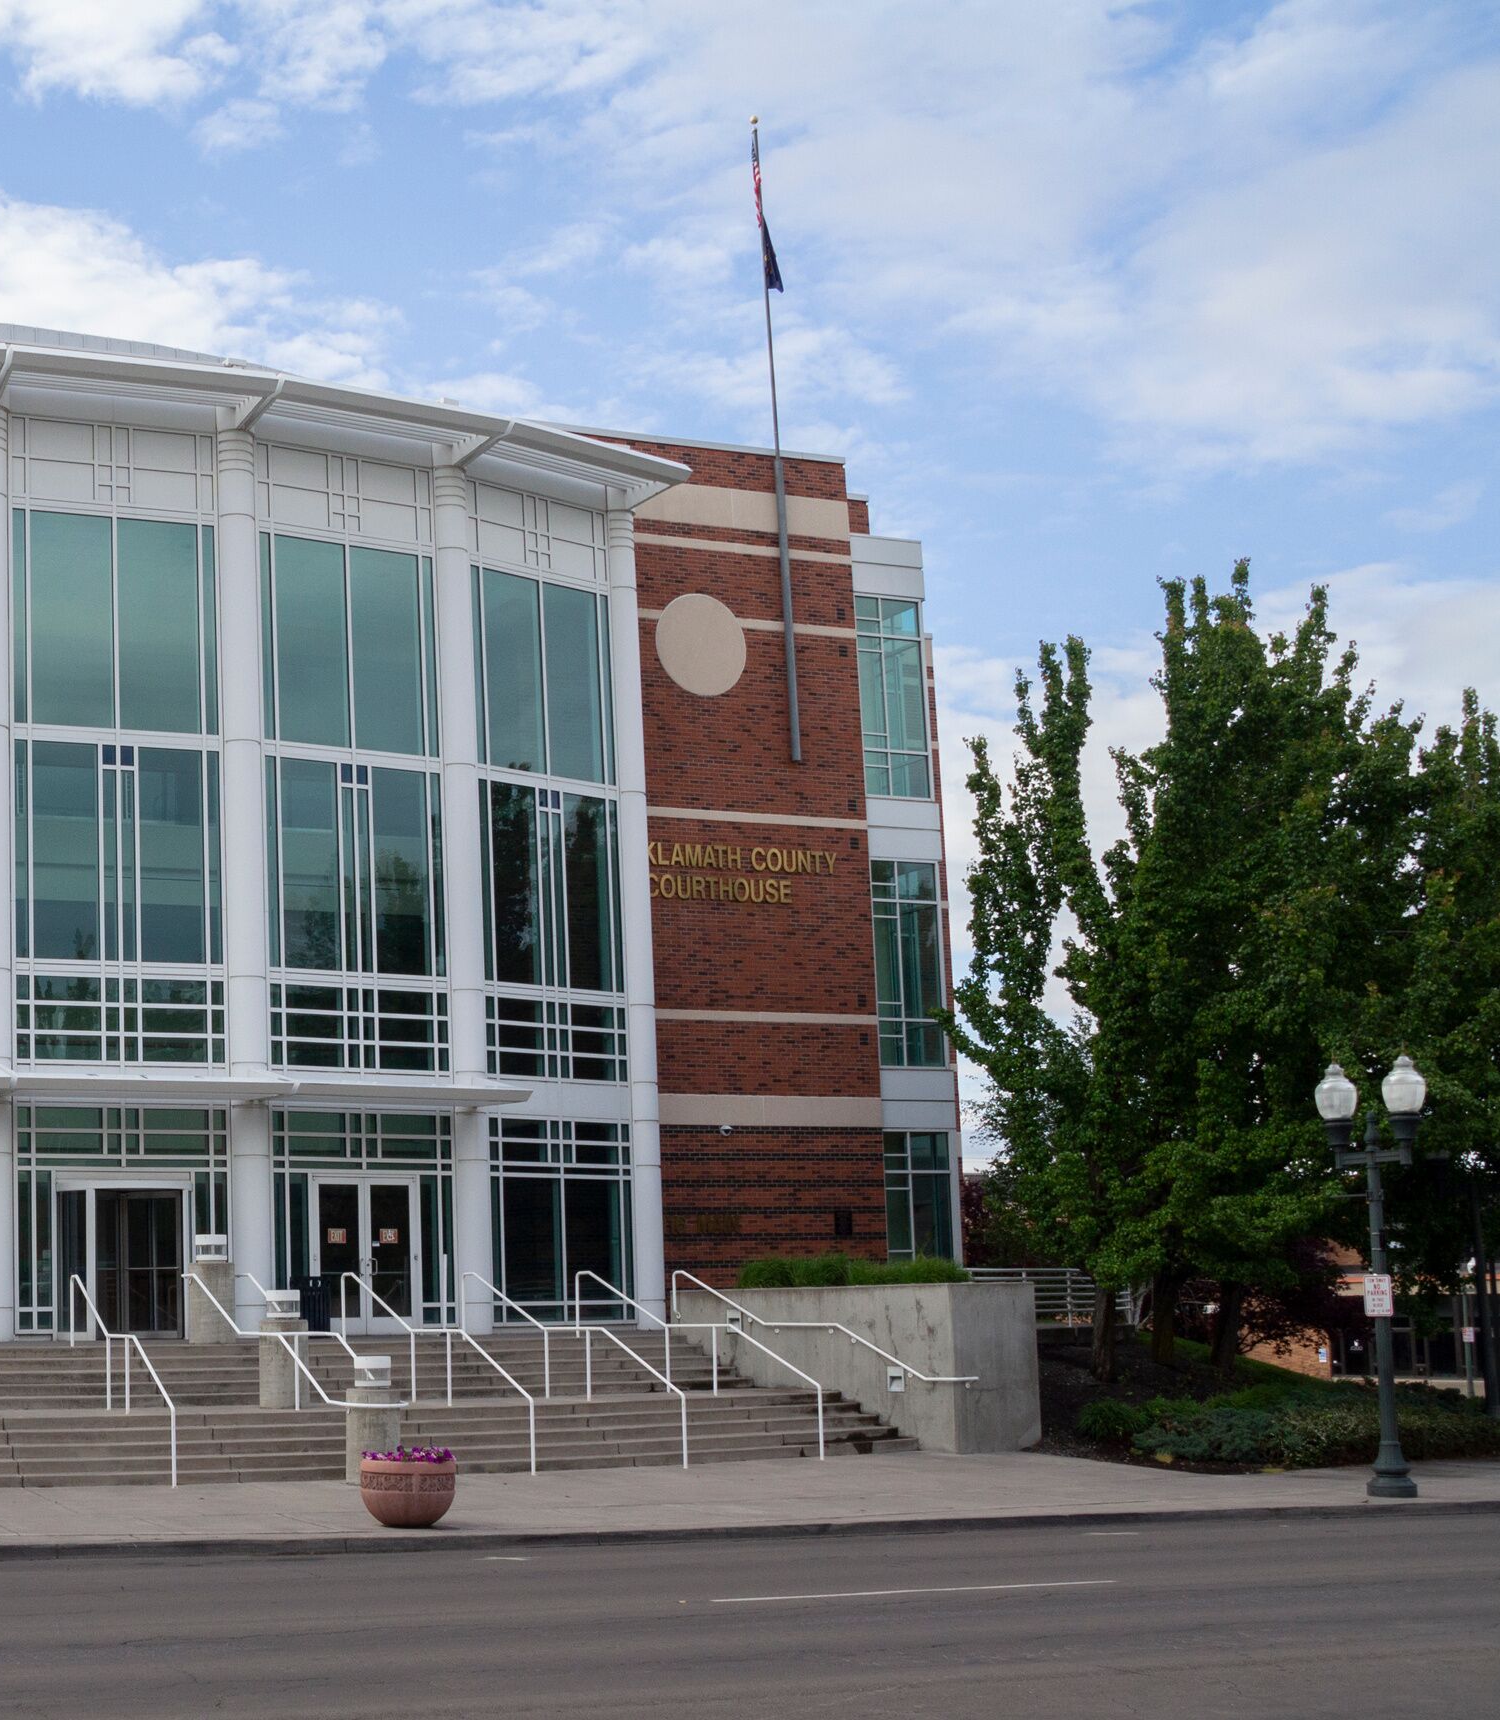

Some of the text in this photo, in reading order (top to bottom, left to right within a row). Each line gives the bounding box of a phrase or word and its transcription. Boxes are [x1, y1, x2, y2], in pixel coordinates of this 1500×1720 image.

[648, 842, 837, 874] KLAMATH COUNTY
[650, 873, 793, 904] COURTHOUSE
